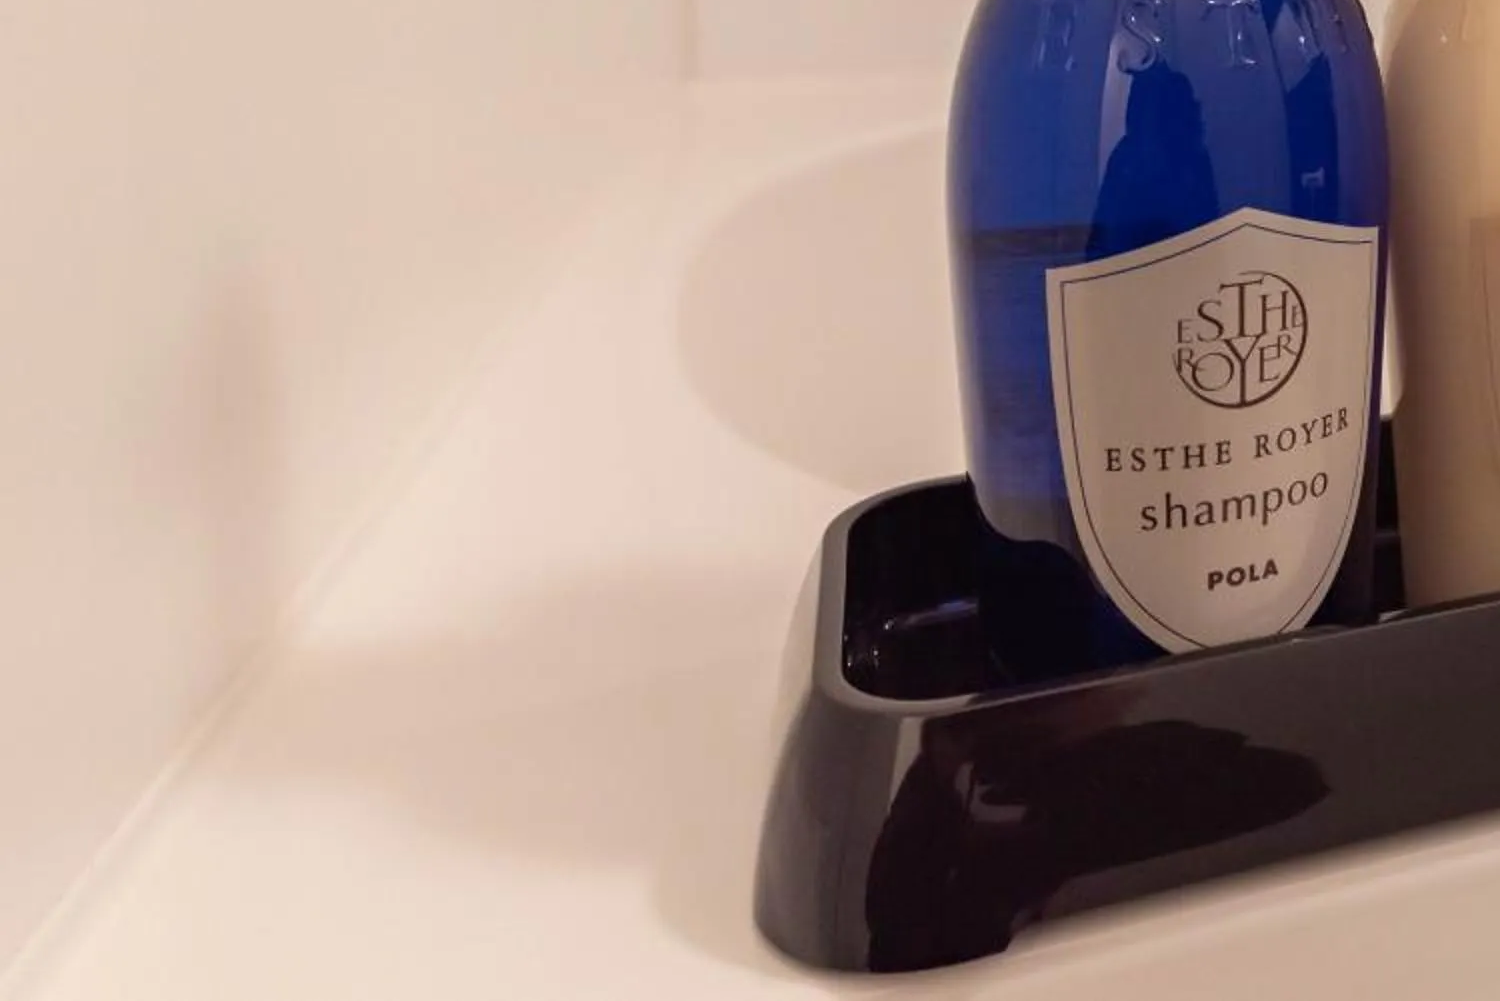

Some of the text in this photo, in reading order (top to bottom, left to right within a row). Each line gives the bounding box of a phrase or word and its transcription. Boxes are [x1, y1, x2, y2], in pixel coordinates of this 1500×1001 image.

[1176, 277, 1305, 343] ESTHE
[1104, 406, 1350, 473] ESTHE ROYER
[1140, 471, 1329, 533] shampoo
[1206, 558, 1280, 592] POLA
